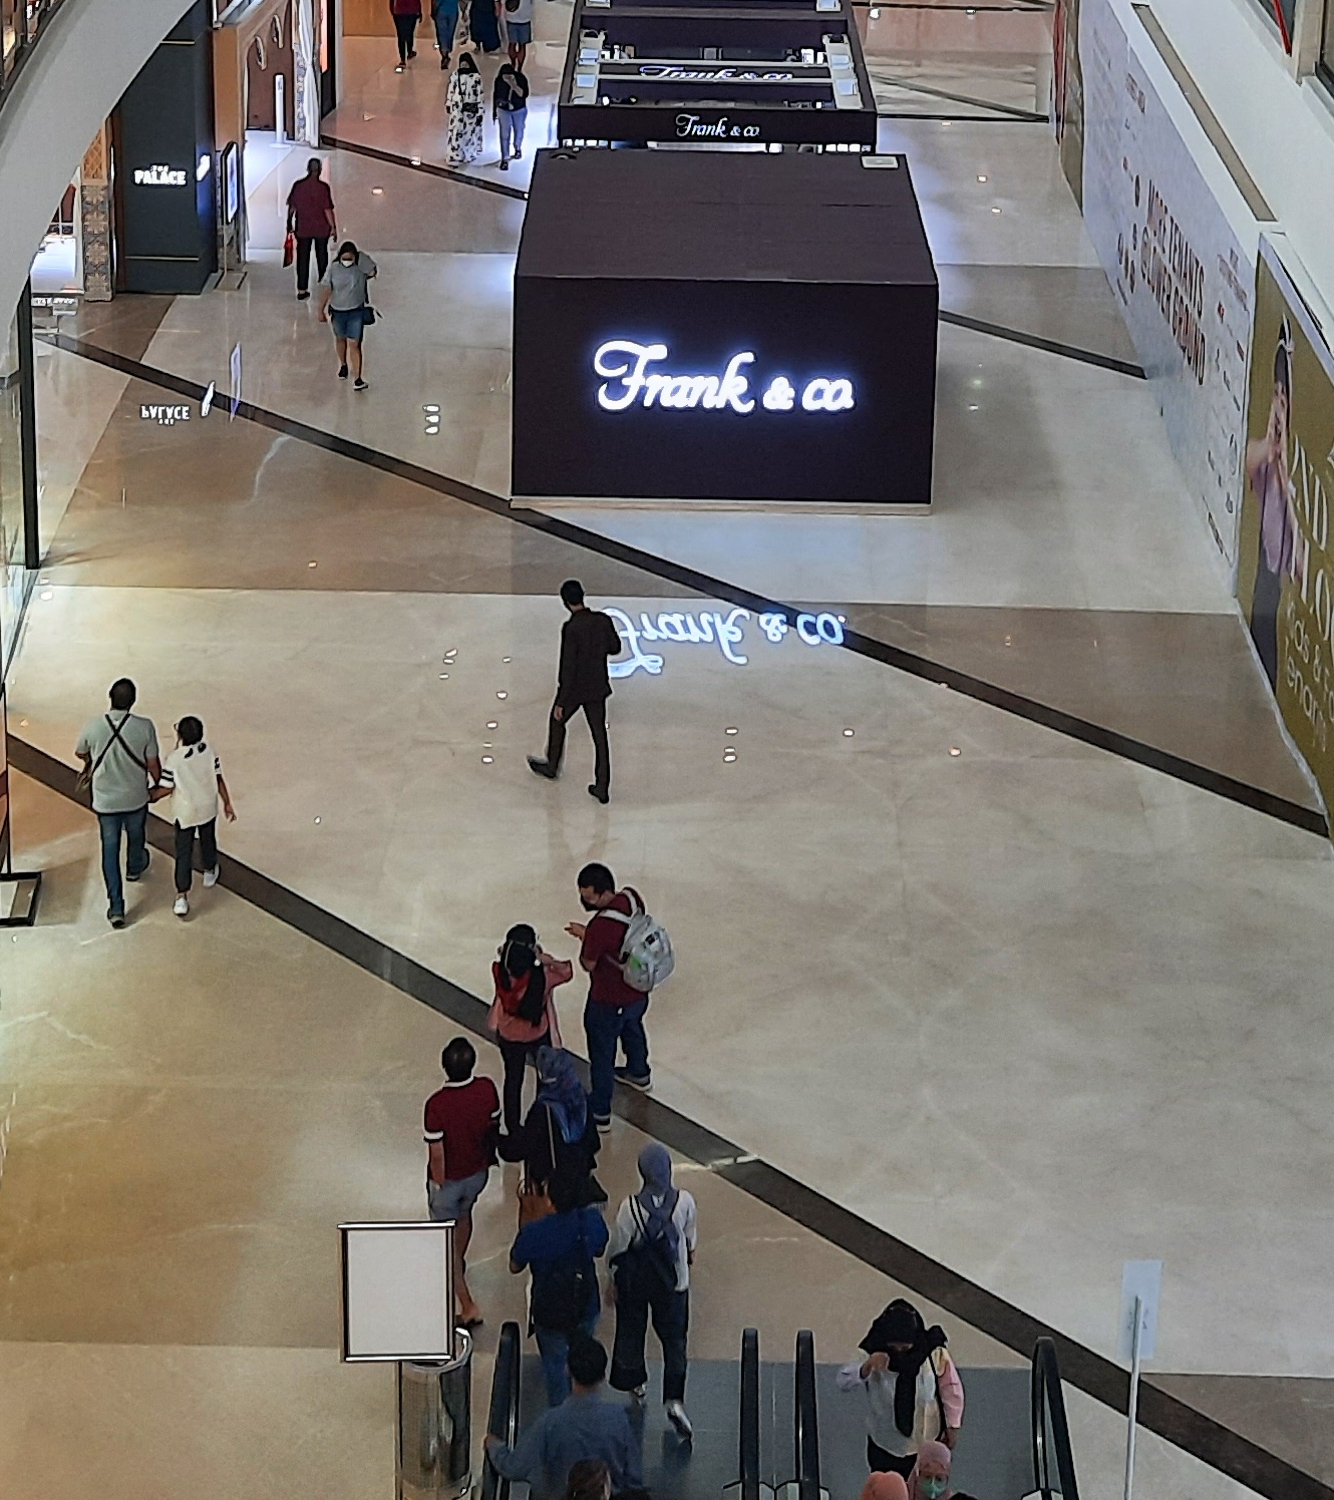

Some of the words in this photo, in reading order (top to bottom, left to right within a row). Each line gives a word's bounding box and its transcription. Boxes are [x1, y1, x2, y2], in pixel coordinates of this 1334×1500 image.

[675, 113, 729, 138] Frank
[134, 170, 187, 186] PALACE
[593, 340, 756, 414] Frank
[762, 376, 796, 411] &
